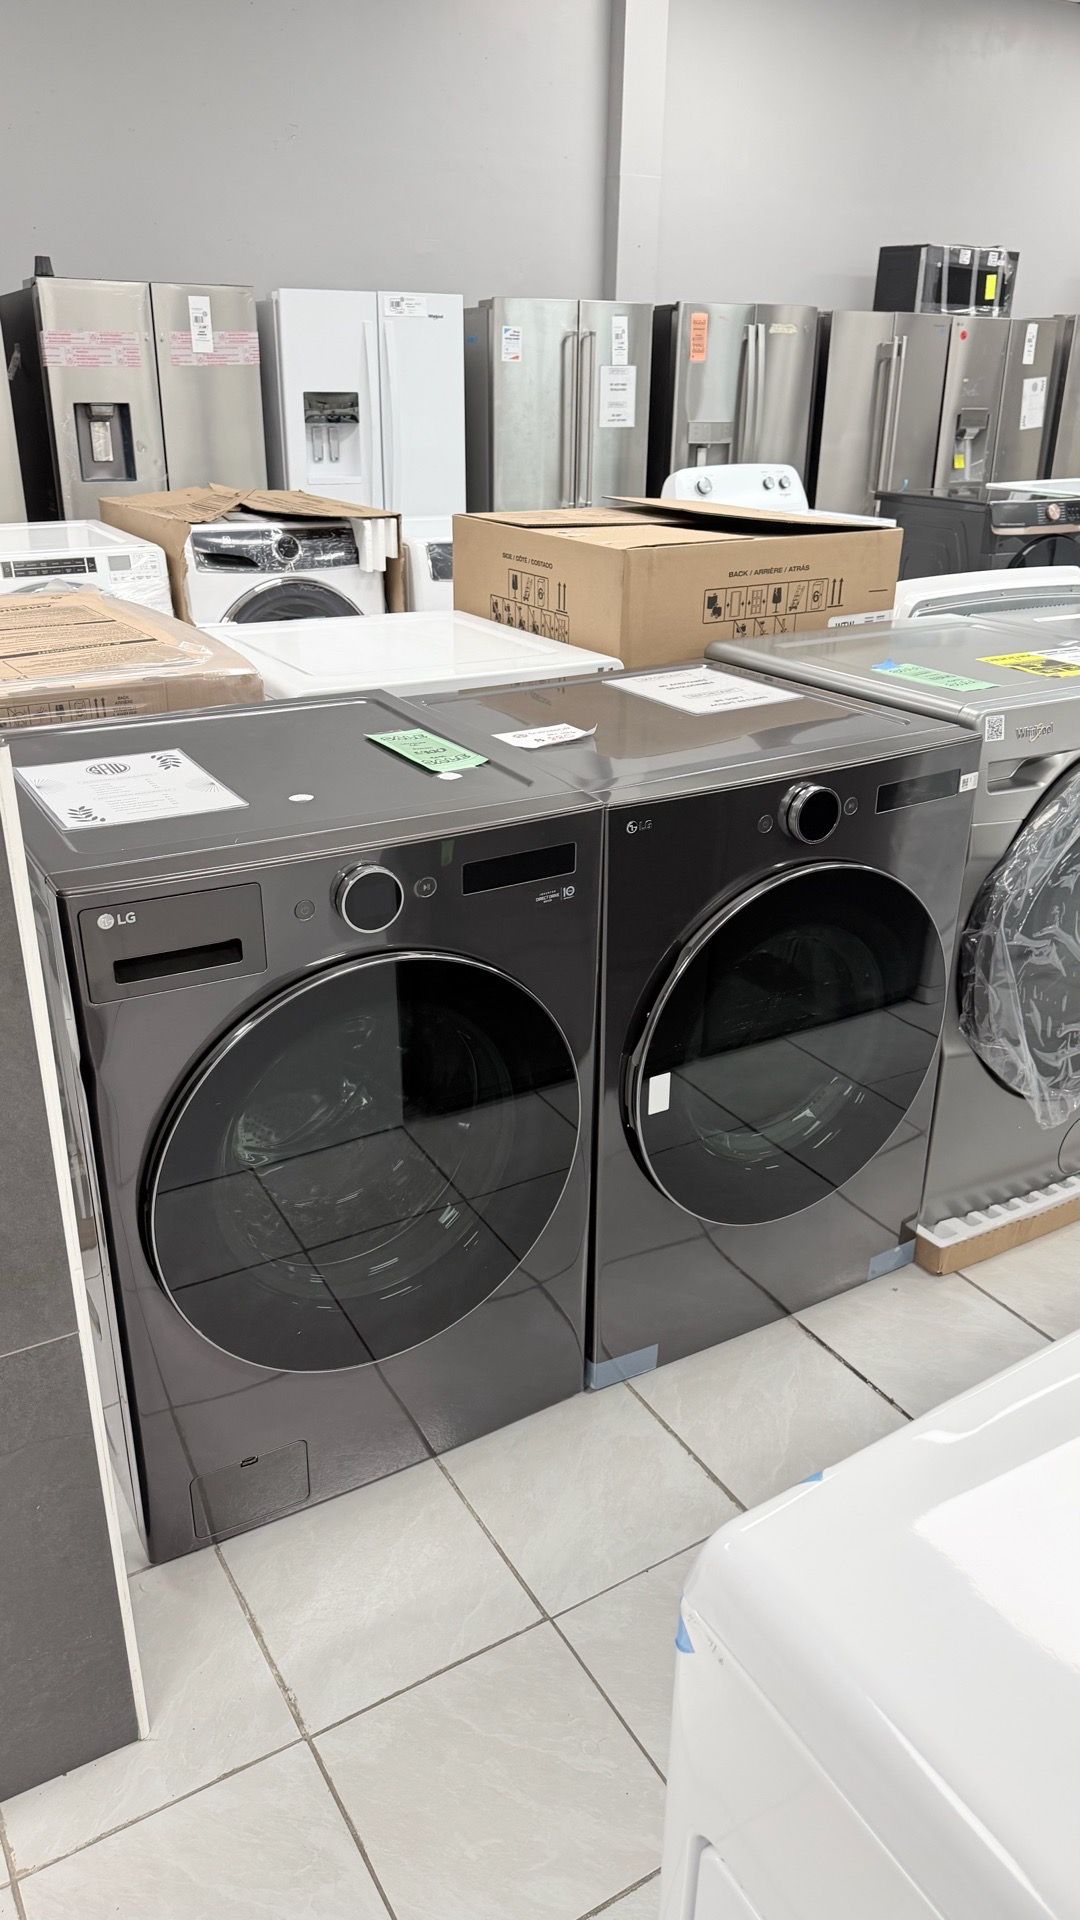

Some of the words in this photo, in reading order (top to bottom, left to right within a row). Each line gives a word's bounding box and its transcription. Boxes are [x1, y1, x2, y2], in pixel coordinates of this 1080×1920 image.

[531, 559, 553, 570] COSTADO
[754, 567, 782, 576] ARRIÈRE
[788, 564, 810, 572] ATRÁS
[1015, 721, 1054, 743] Whirlpool
[638, 819, 653, 831] LG
[116, 911, 136, 926] LG
